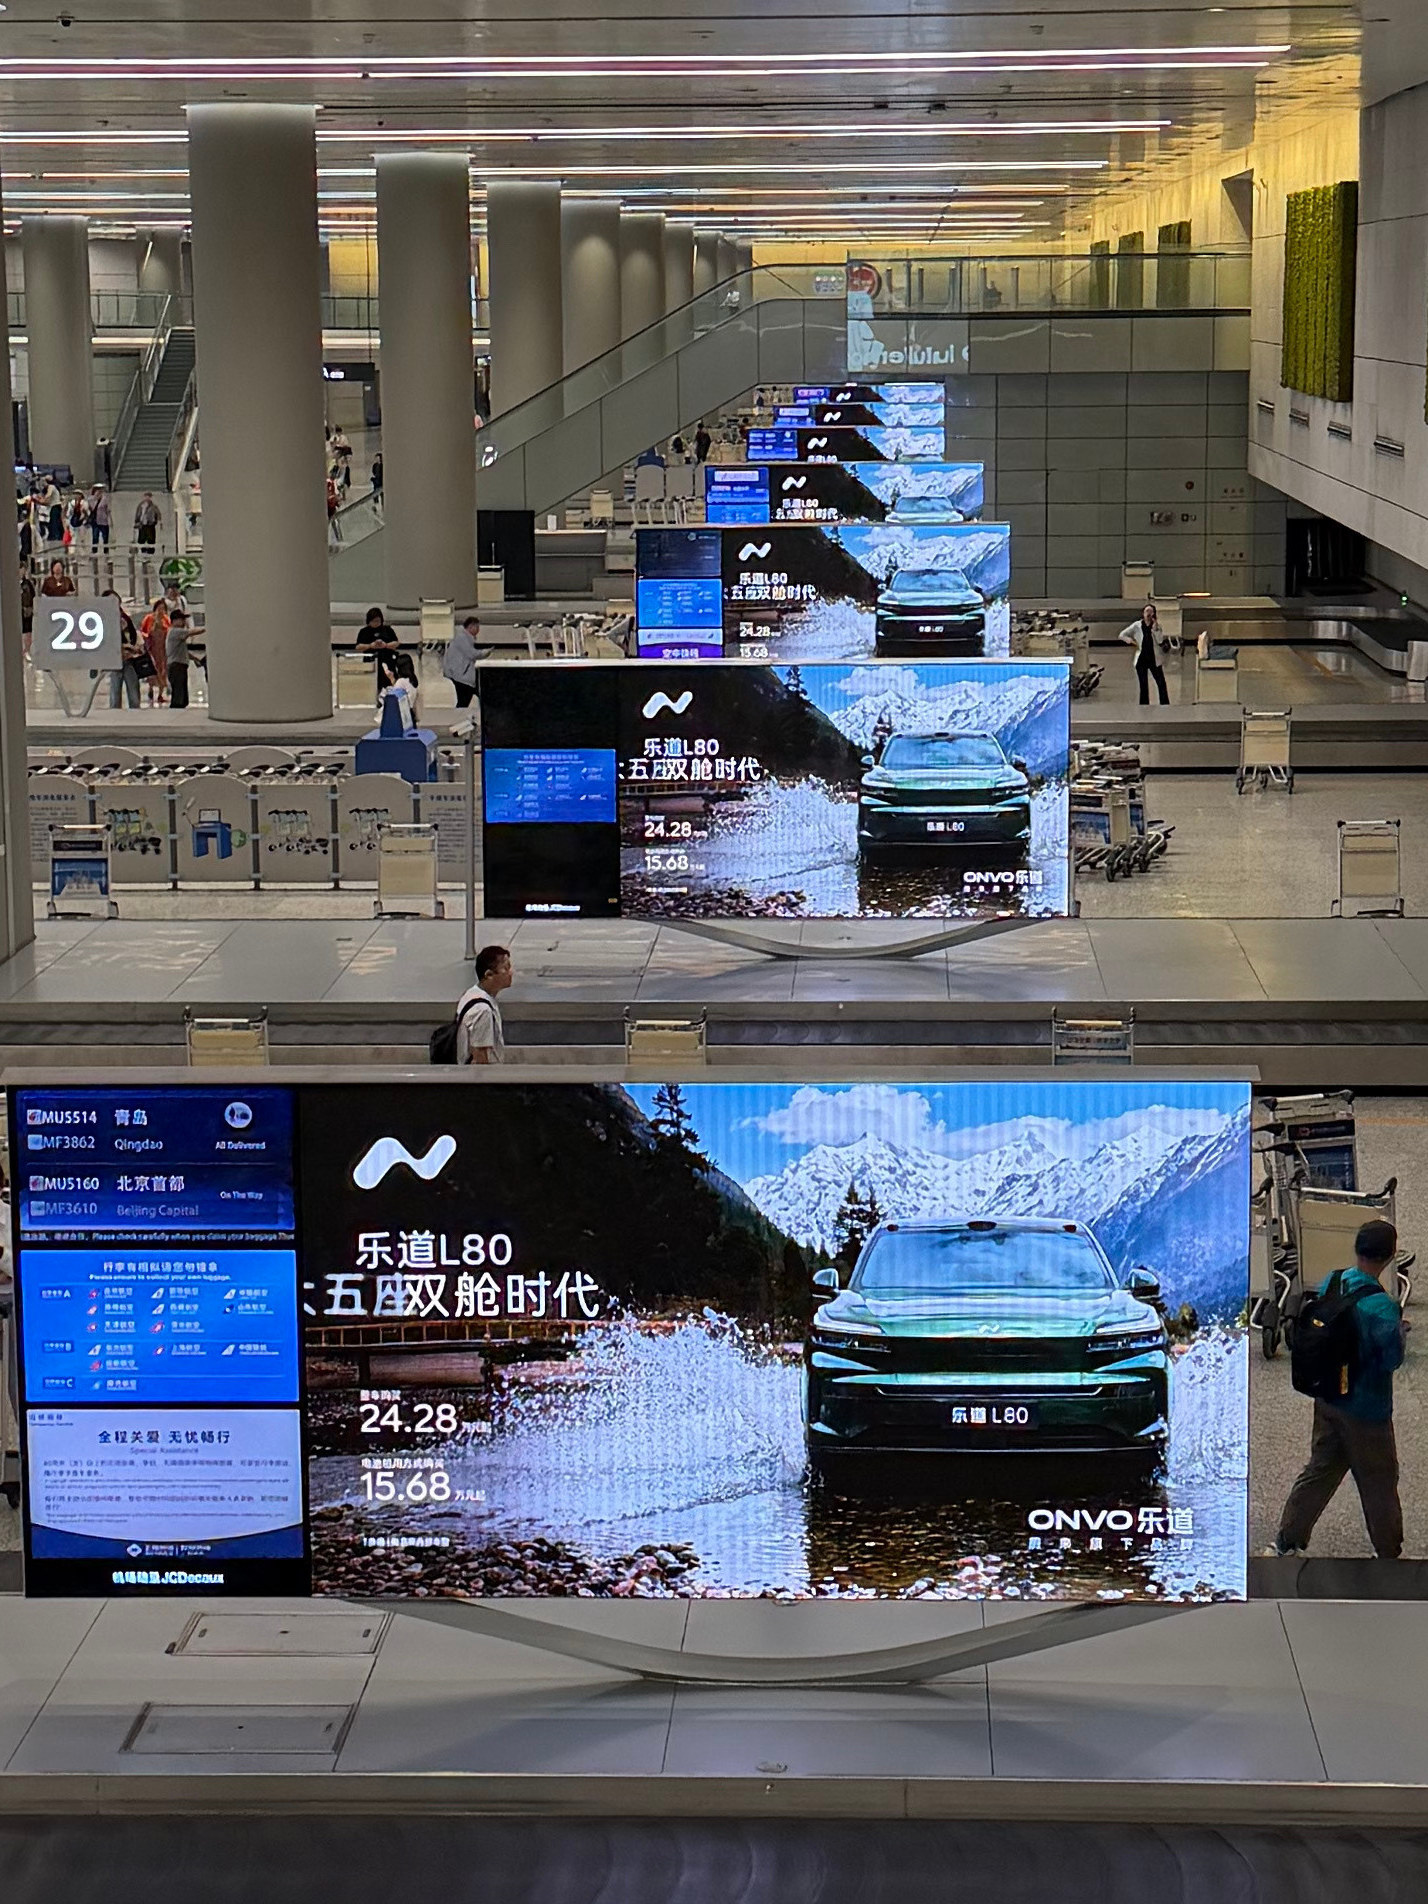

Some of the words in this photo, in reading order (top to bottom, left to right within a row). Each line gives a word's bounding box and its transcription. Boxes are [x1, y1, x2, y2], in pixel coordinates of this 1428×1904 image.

[724, 584, 817, 600] 五座双舱时代
[50, 611, 105, 651] 29
[643, 737, 720, 757] 乐道L80
[619, 757, 762, 781] 五座双舱时代
[644, 822, 692, 837] 24.28
[645, 855, 689, 870] 15.68
[963, 871, 1015, 883] ONVO
[42, 1110, 97, 1125] MU5514
[114, 1109, 148, 1126] 青岛
[42, 1136, 96, 1149] MF3862
[114, 1139, 163, 1152] Qingdao
[43, 1177, 100, 1191] MU5160
[116, 1175, 185, 1192] 北京首都
[45, 1203, 98, 1215] MF3610
[116, 1205, 157, 1218] Beijing
[158, 1204, 199, 1217] Capital
[356, 1229, 513, 1270] 乐道L80
[359, 1403, 457, 1433] 24.28
[992, 1407, 1029, 1424] L80
[360, 1471, 451, 1501] 15.68
[1028, 1509, 1133, 1531] ONVO
[1136, 1507, 1194, 1535] 乐道
